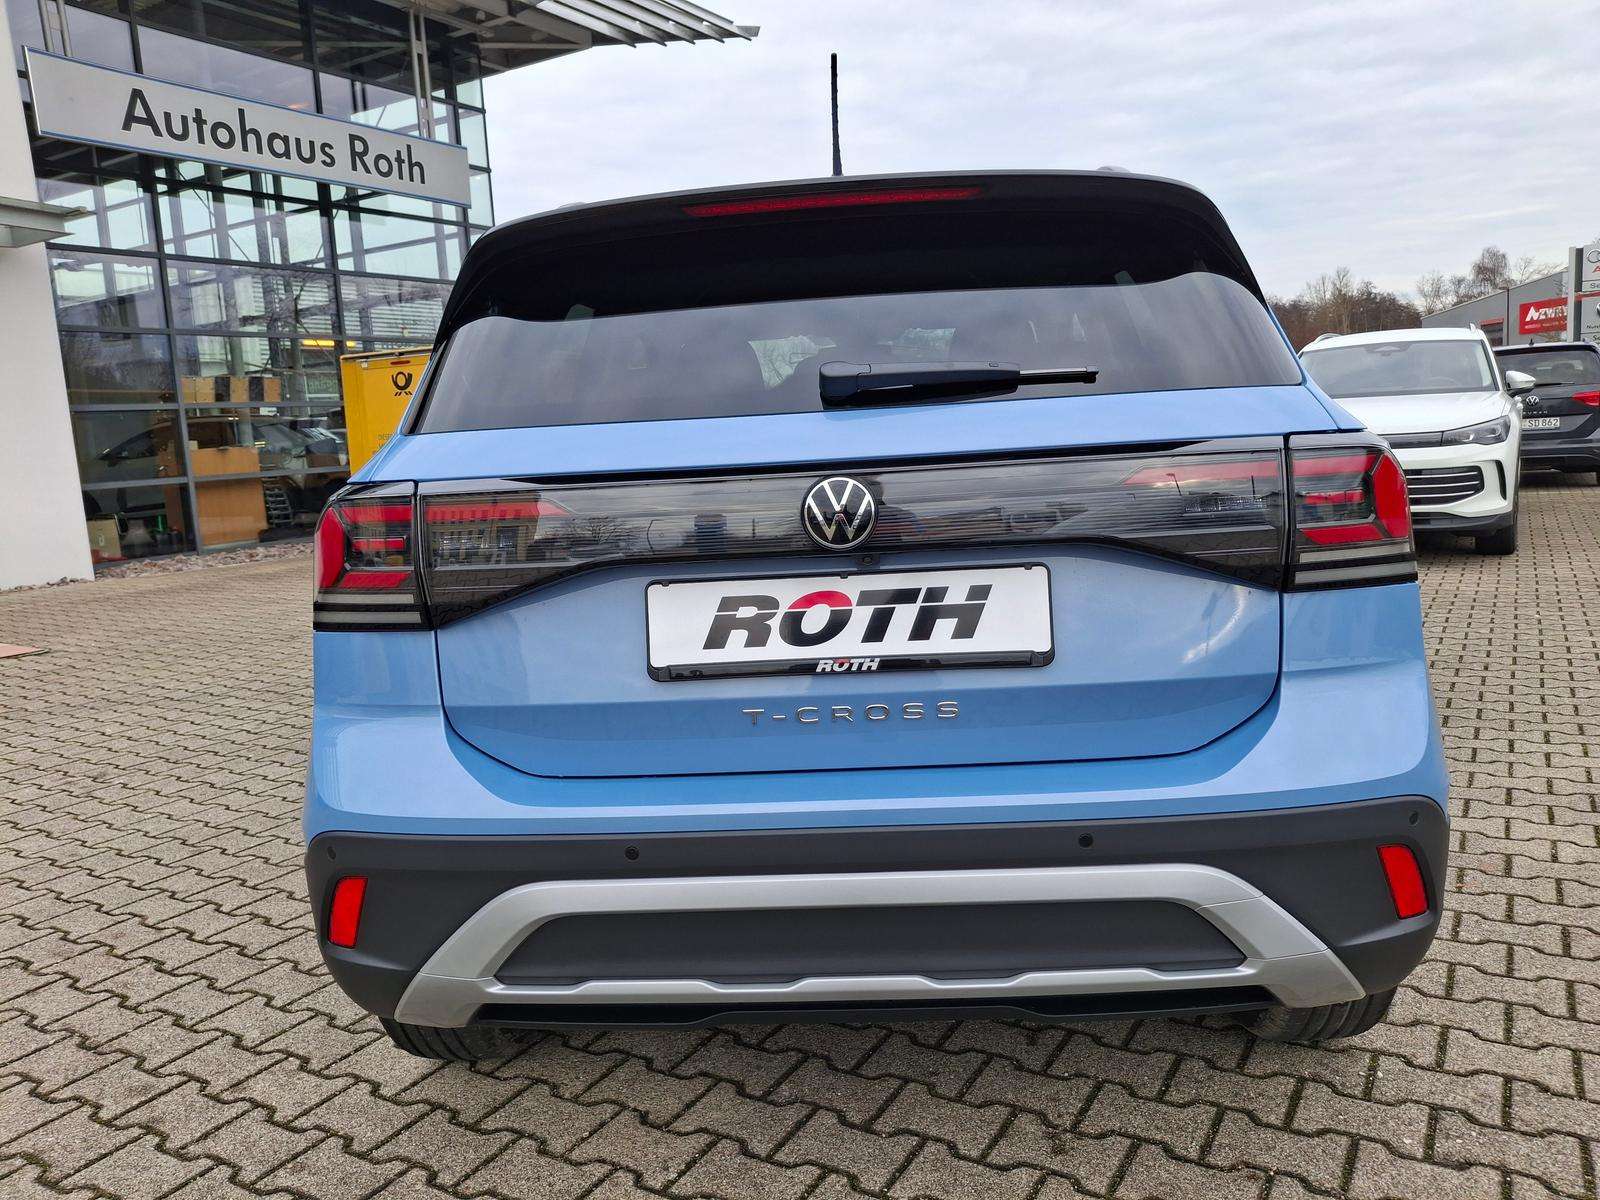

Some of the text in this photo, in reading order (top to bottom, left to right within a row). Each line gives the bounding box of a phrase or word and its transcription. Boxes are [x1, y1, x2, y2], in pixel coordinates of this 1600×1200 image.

[121, 87, 426, 185] Autohaus Roth
[1528, 418, 1559, 428] SD 862
[702, 583, 993, 650] ROTH
[815, 657, 881, 673] ROTH
[742, 700, 961, 726] T-CROSS
